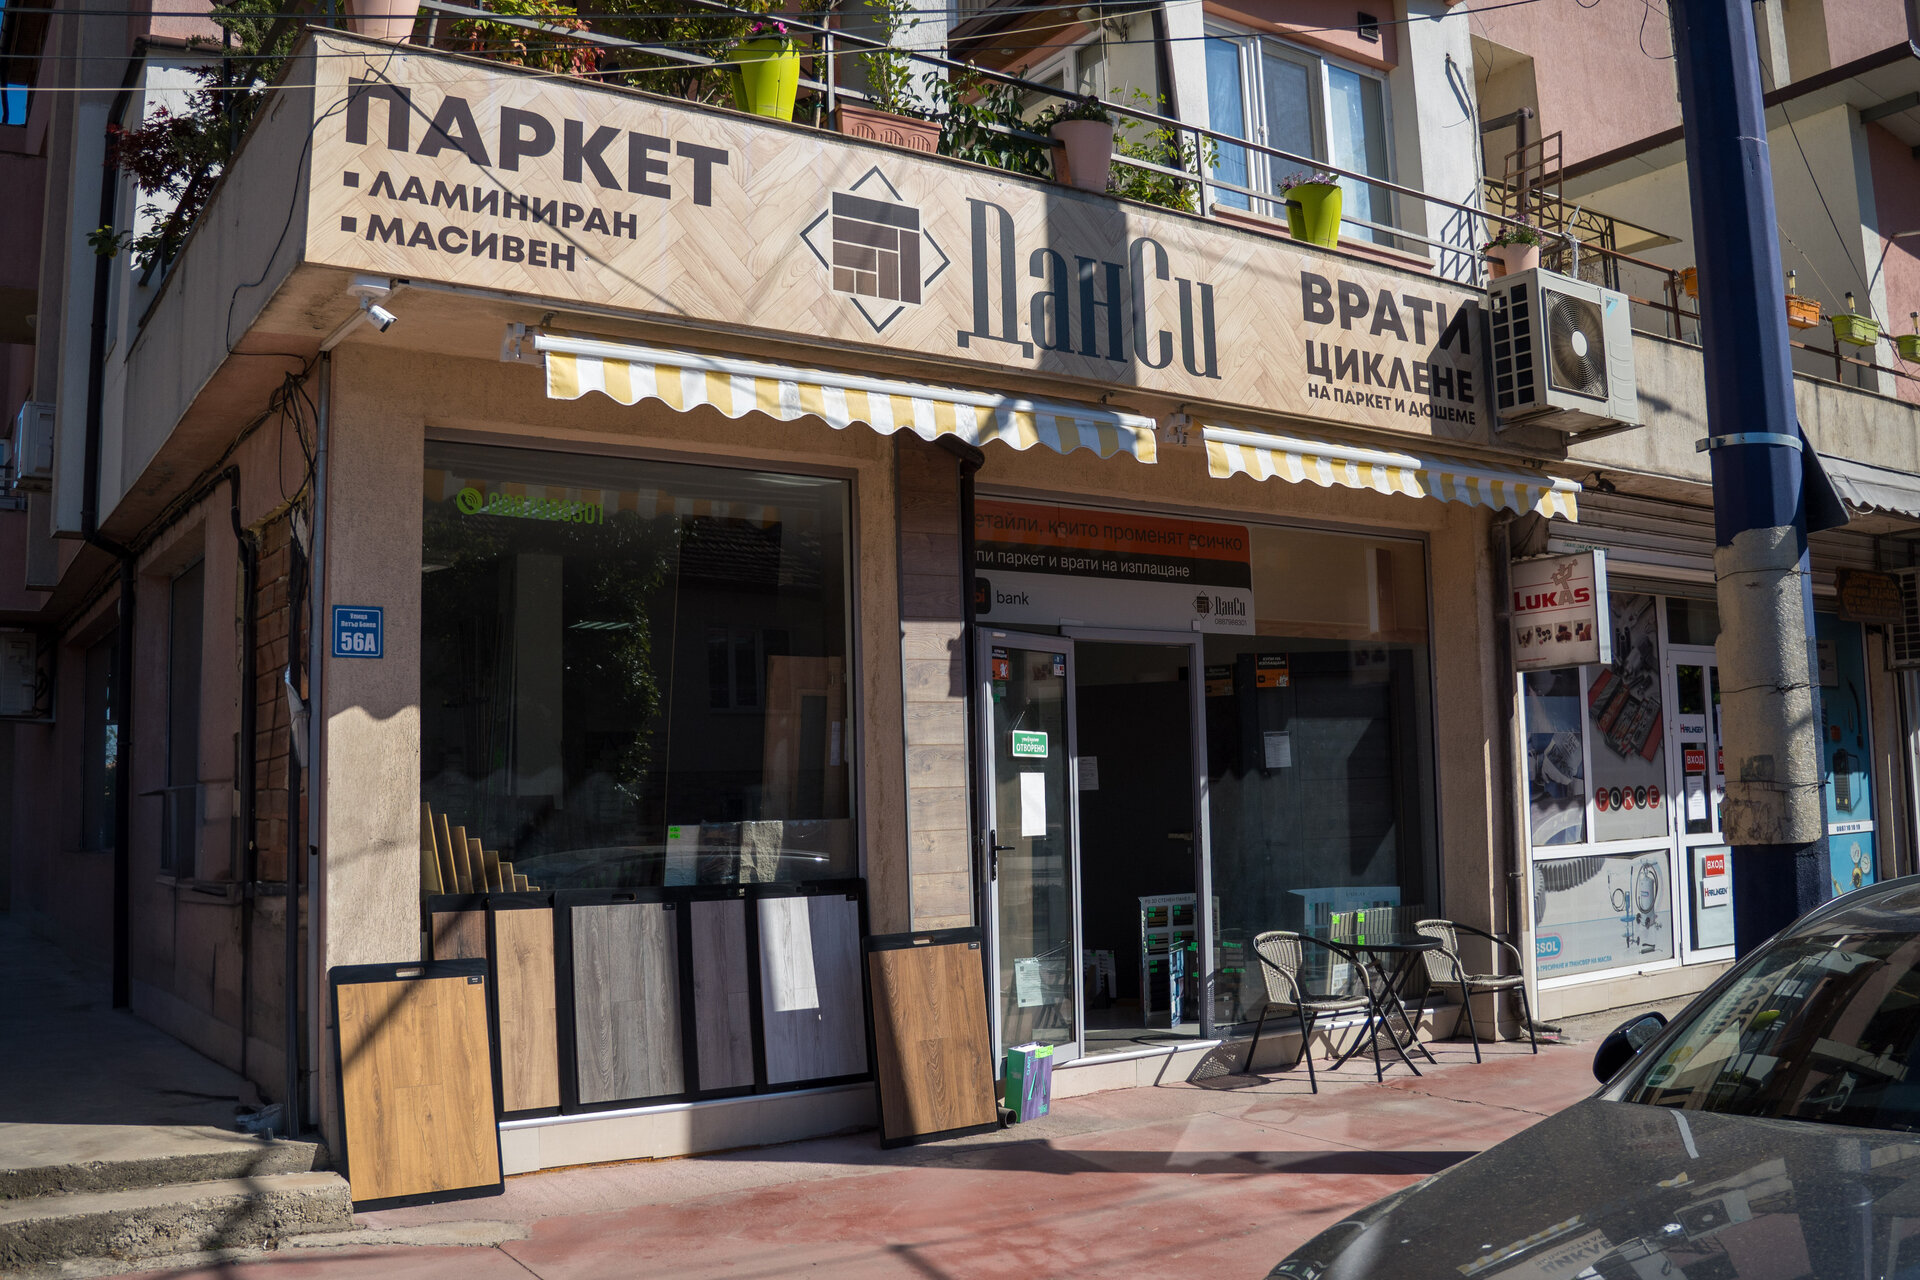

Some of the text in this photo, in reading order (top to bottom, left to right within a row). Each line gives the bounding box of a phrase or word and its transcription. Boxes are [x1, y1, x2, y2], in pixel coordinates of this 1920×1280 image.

[346, 77, 729, 207] ПАРКЕТ
[368, 170, 637, 240] ЛАМИНИРАН
[366, 214, 575, 272] МАСИВЕН
[957, 197, 1221, 380] ДанСи
[1301, 270, 1479, 355] ВРАТИ
[1306, 340, 1474, 404] ЦИКЛЕНЕ
[1308, 383, 1476, 425] НА ПАРКЕТ И ДЮШЕМЕ
[1048, 520, 1098, 538] които
[1103, 525, 1184, 545] променят
[1188, 533, 1242, 550] всичко
[997, 551, 1046, 568] паркет
[1049, 556, 1057, 567] и
[1061, 557, 1098, 572] врати
[1102, 560, 1118, 572] на
[1120, 561, 1190, 578] изплащане
[996, 590, 1029, 606] bank
[1214, 596, 1246, 616] ДанСи
[1513, 587, 1590, 612] LUKAS
[1016, 743, 1045, 753] ОТВОРЕНО
[1687, 755, 1704, 765] ВХОД
[1597, 786, 1659, 810] FORCE
[1706, 859, 1724, 870] ВХОД
